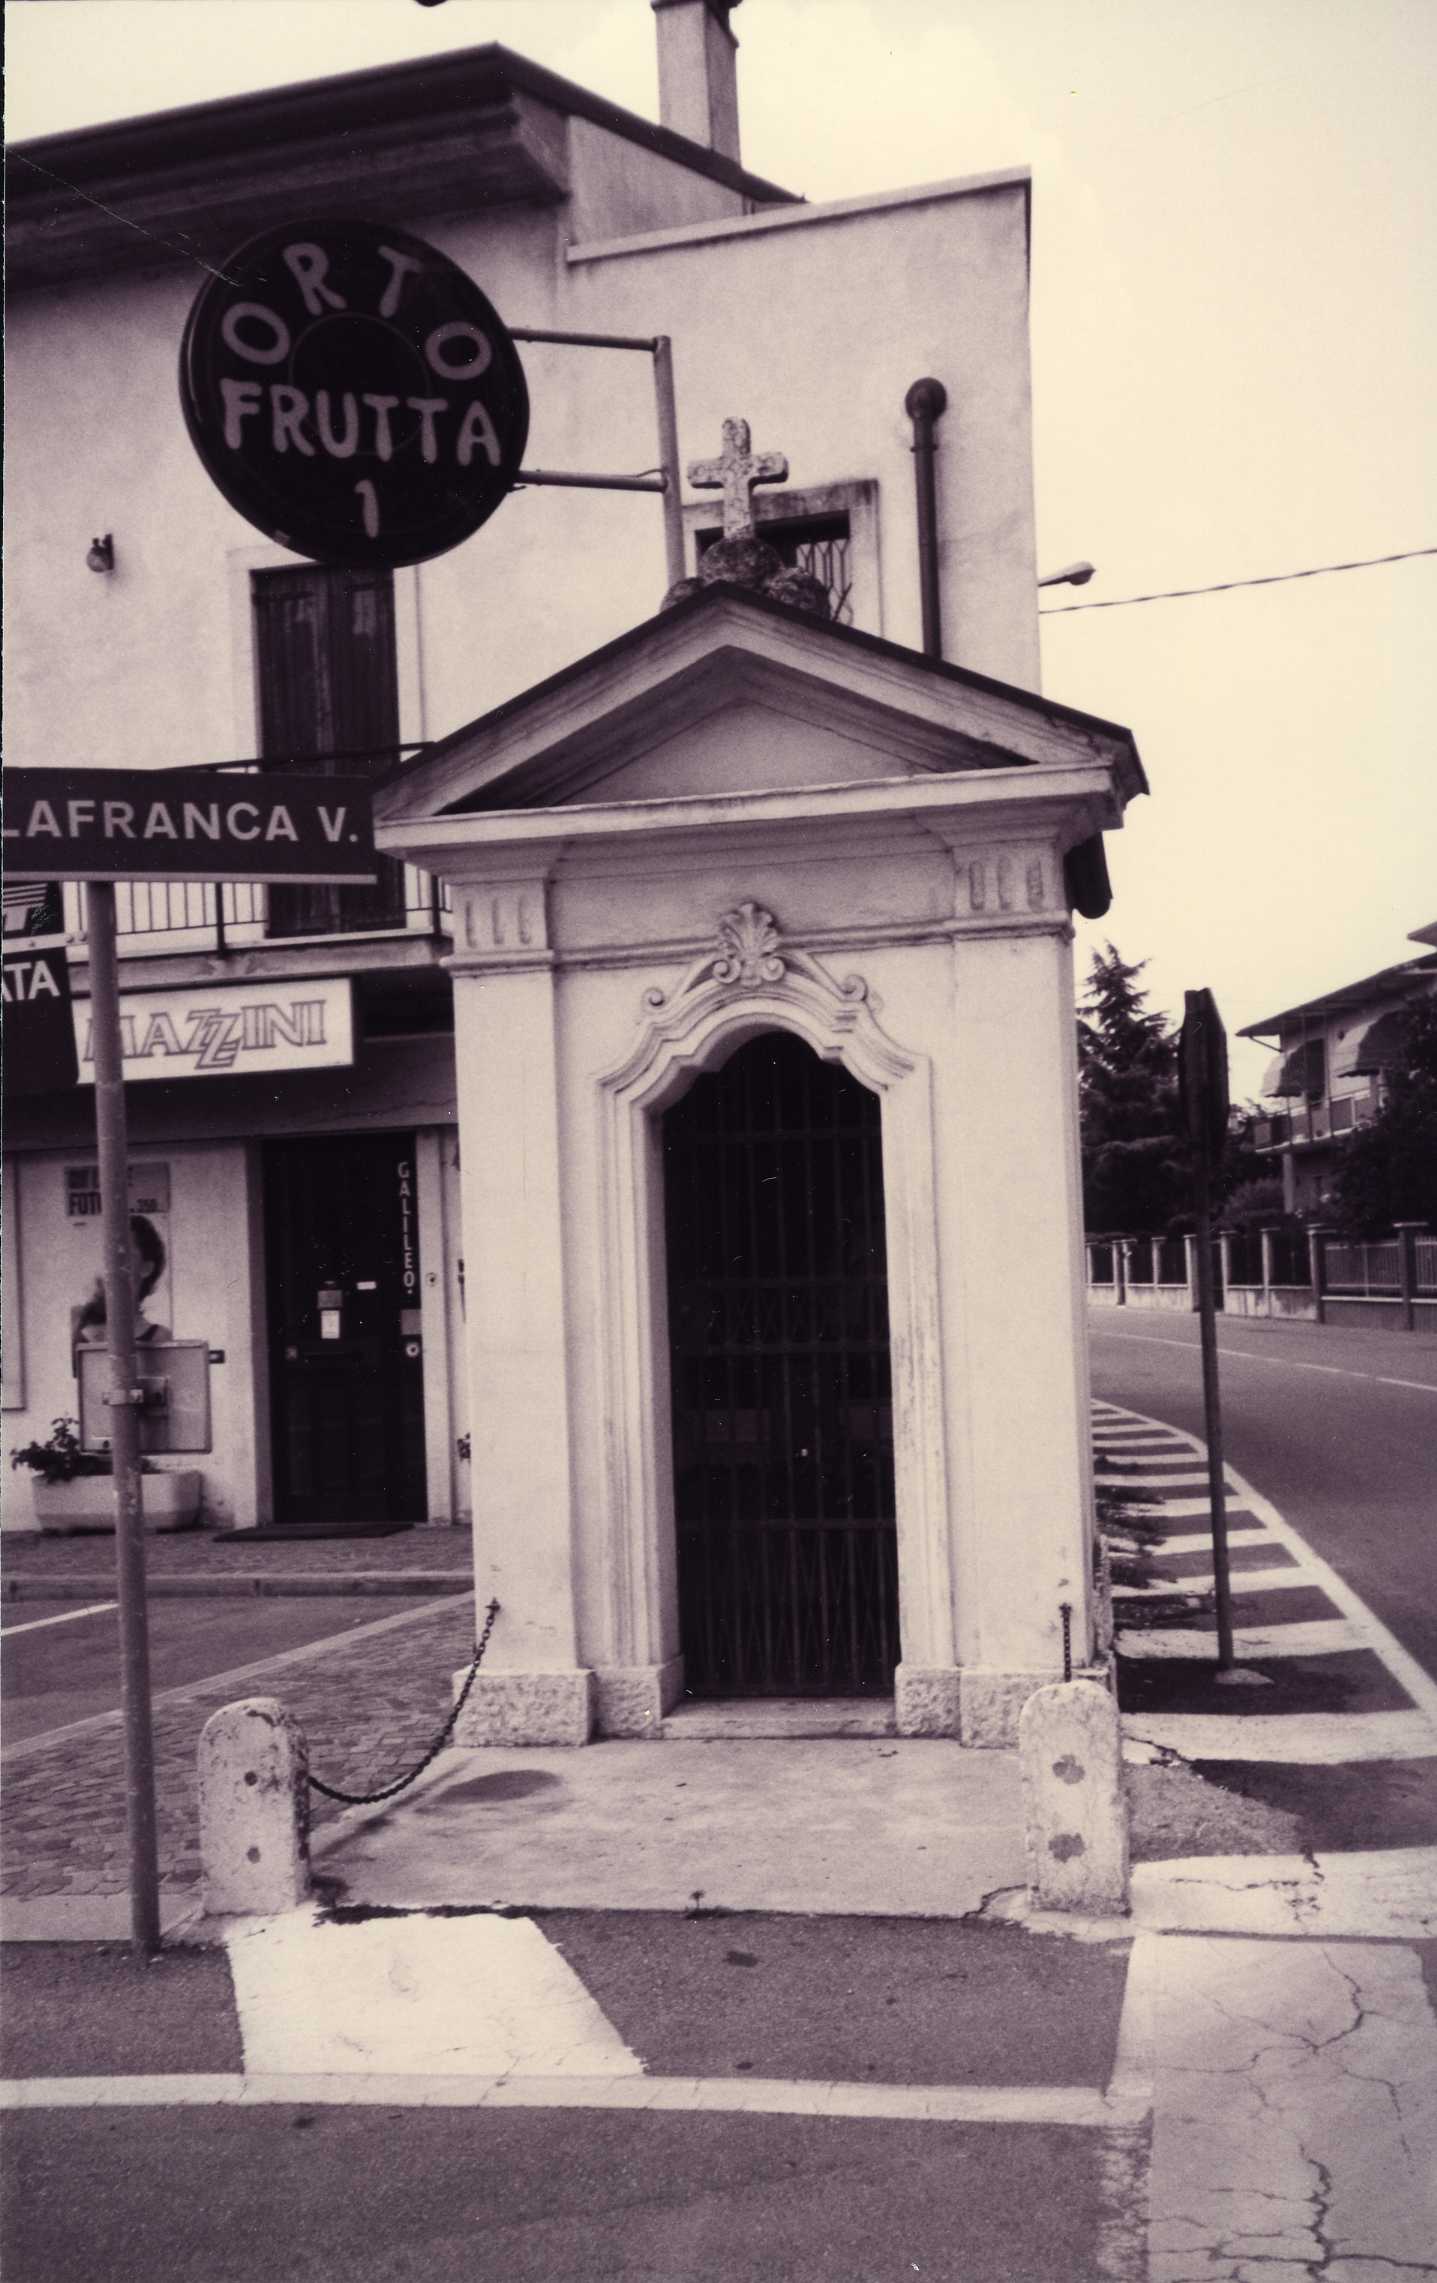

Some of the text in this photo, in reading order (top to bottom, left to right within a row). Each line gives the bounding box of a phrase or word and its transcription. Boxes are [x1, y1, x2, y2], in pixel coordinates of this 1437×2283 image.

[220, 242, 493, 381] ORTO
[219, 377, 501, 467] FRUTTA
[354, 479, 380, 538] 1
[317, 806, 359, 843] V.
